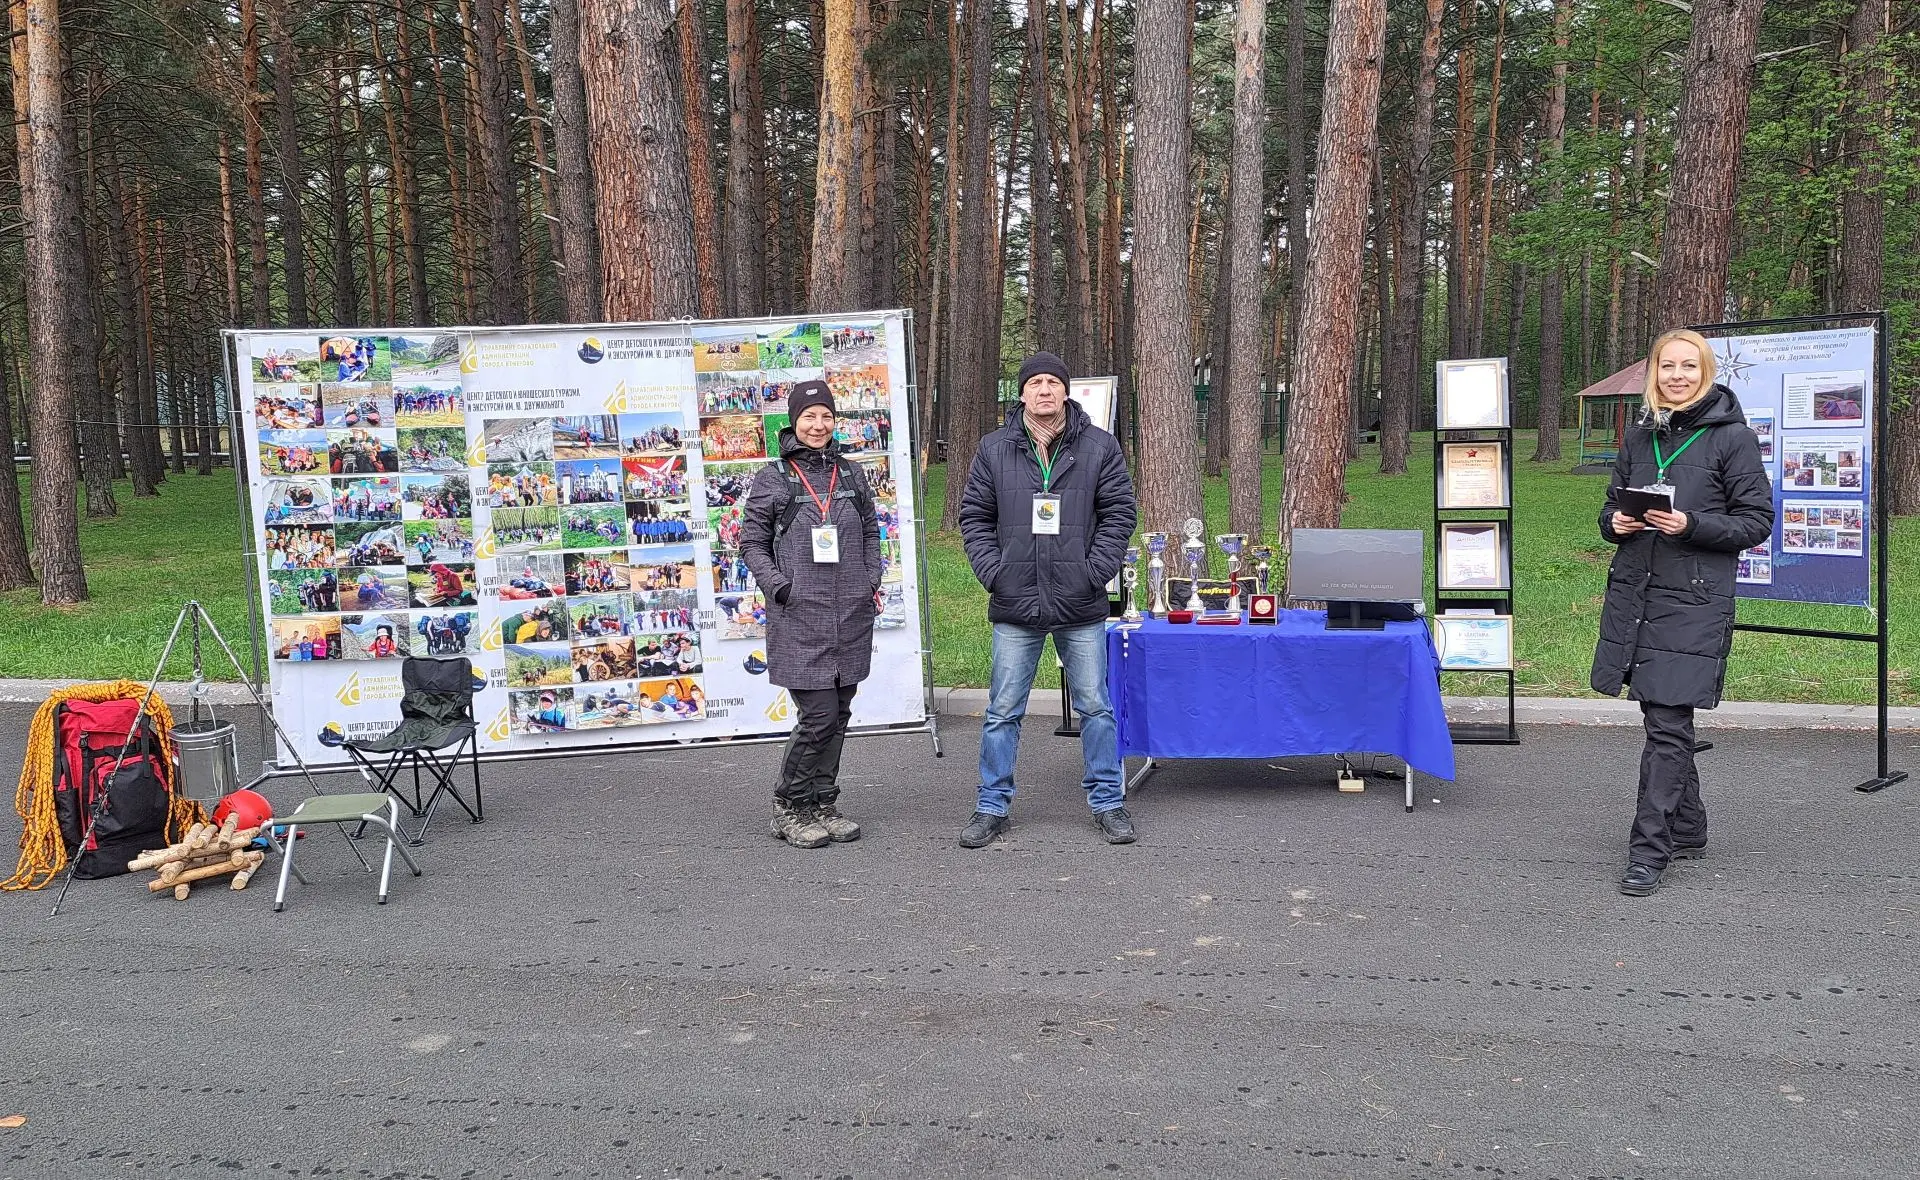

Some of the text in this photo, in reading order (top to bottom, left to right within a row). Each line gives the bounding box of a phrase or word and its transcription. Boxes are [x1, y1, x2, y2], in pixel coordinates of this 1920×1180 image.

[607, 339, 624, 349] ЦЕНТР
[625, 339, 652, 349] ДЕТСКОГО
[653, 339, 658, 347] И
[608, 351, 612, 360] И
[613, 349, 645, 360] ЭКСКУРСИЙ
[466, 388, 581, 401] ЦЕНТР ДЕТСКОГО И ЮНОШЕСКОГО ТУРИЗМА
[472, 402, 505, 412] ЭКСКУРСИЙ
[1197, 586, 1232, 595] OODYEAR
[720, 697, 745, 706] ТУРИЗМА
[347, 722, 365, 732] ЦЕНТР
[366, 720, 394, 731] ДЕТСКОГО
